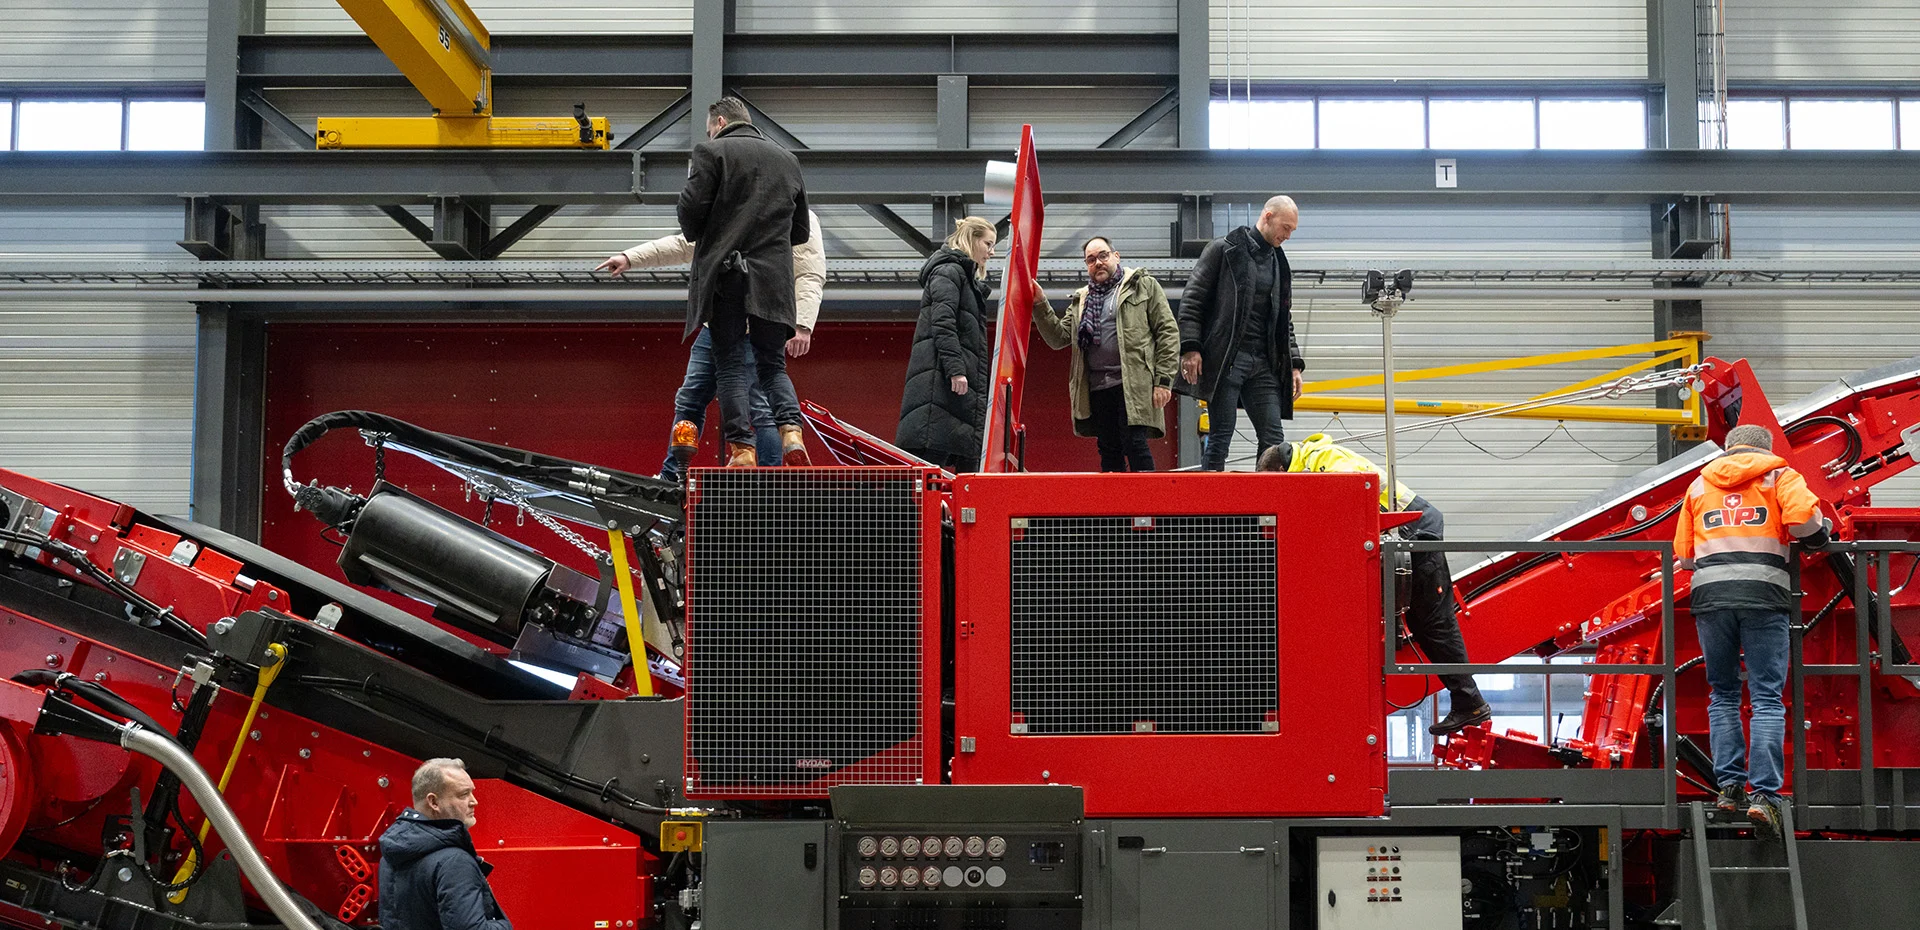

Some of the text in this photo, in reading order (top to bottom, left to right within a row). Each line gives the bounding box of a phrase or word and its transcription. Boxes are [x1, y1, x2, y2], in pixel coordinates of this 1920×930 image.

[439, 26, 450, 50] 55
[1440, 165, 1453, 181] T
[1702, 506, 1768, 530] GIPO
